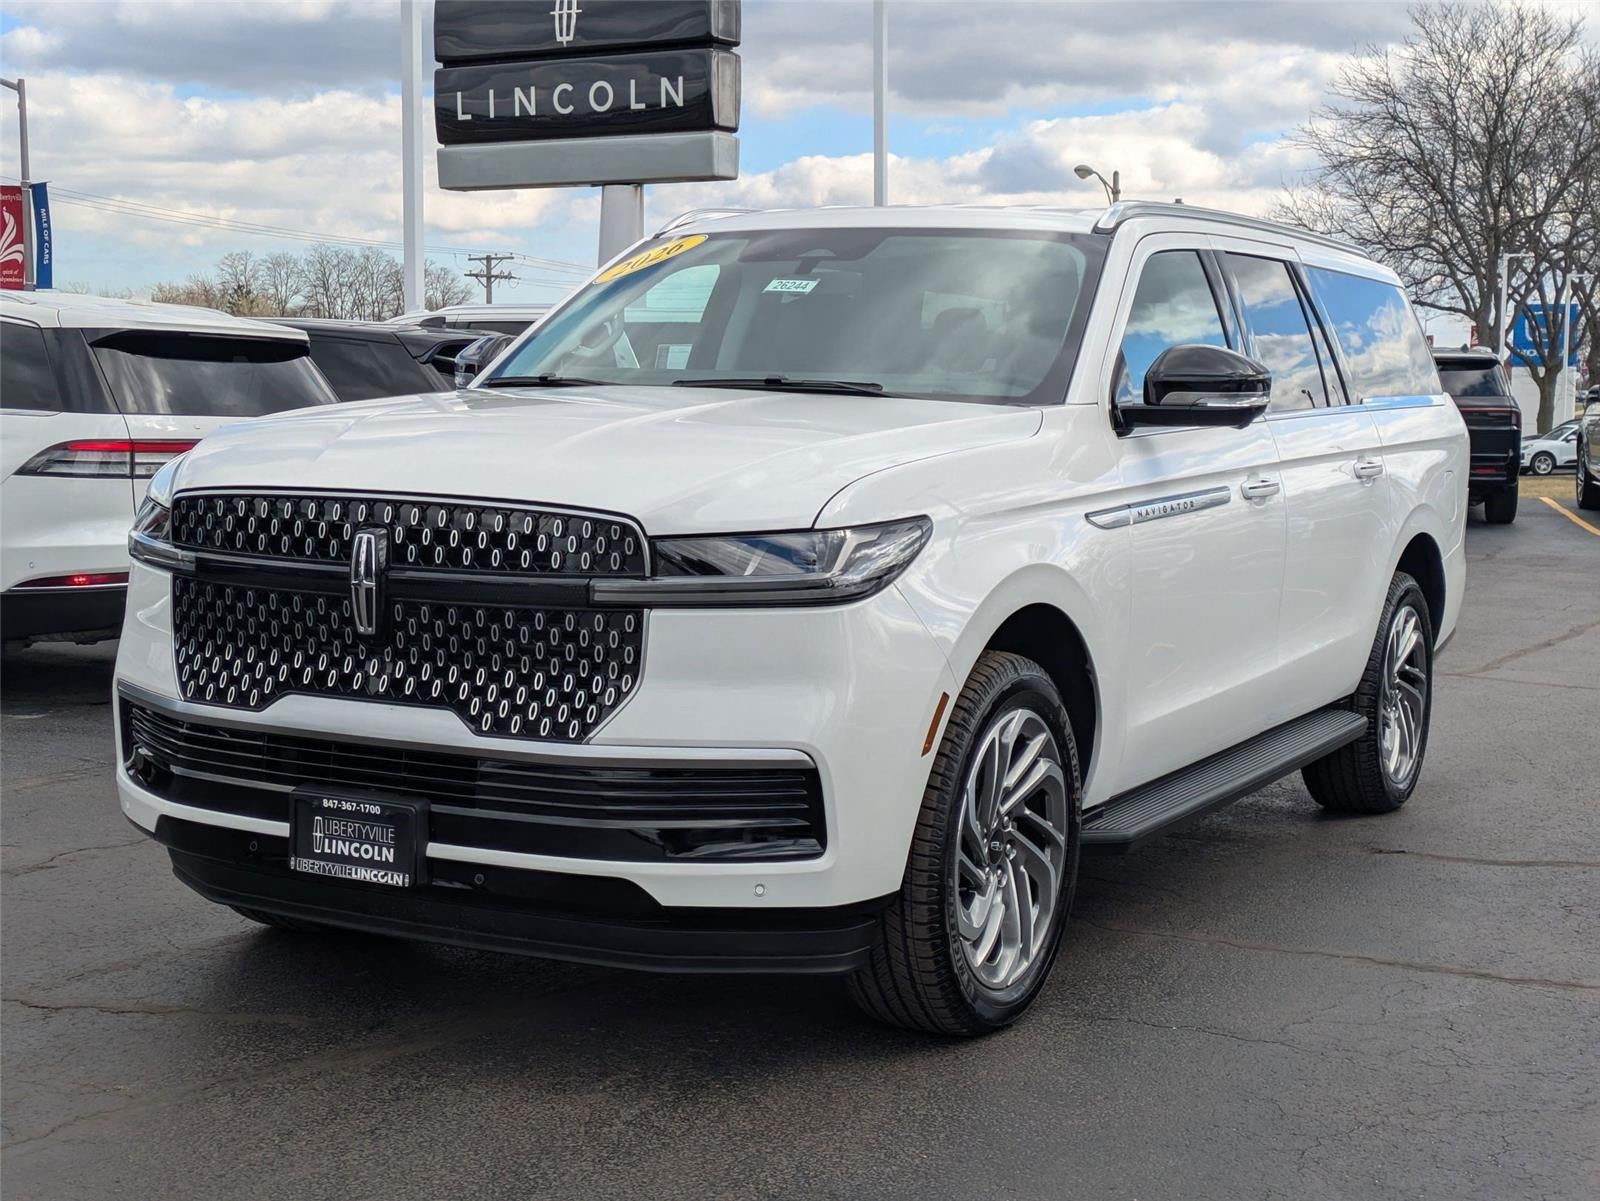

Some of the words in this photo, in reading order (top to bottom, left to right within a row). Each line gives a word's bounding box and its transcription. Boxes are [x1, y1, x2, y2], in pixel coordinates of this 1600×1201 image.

[456, 76, 684, 121] LINCOLN
[40, 208, 48, 229] MILE
[43, 229, 49, 242] OF
[771, 281, 810, 290] 26244
[1137, 500, 1195, 518] NAVIGATOR
[322, 798, 381, 815] 847-367-1700
[324, 819, 396, 844] LIBERTYVILLE
[323, 838, 395, 863] LINCOLN
